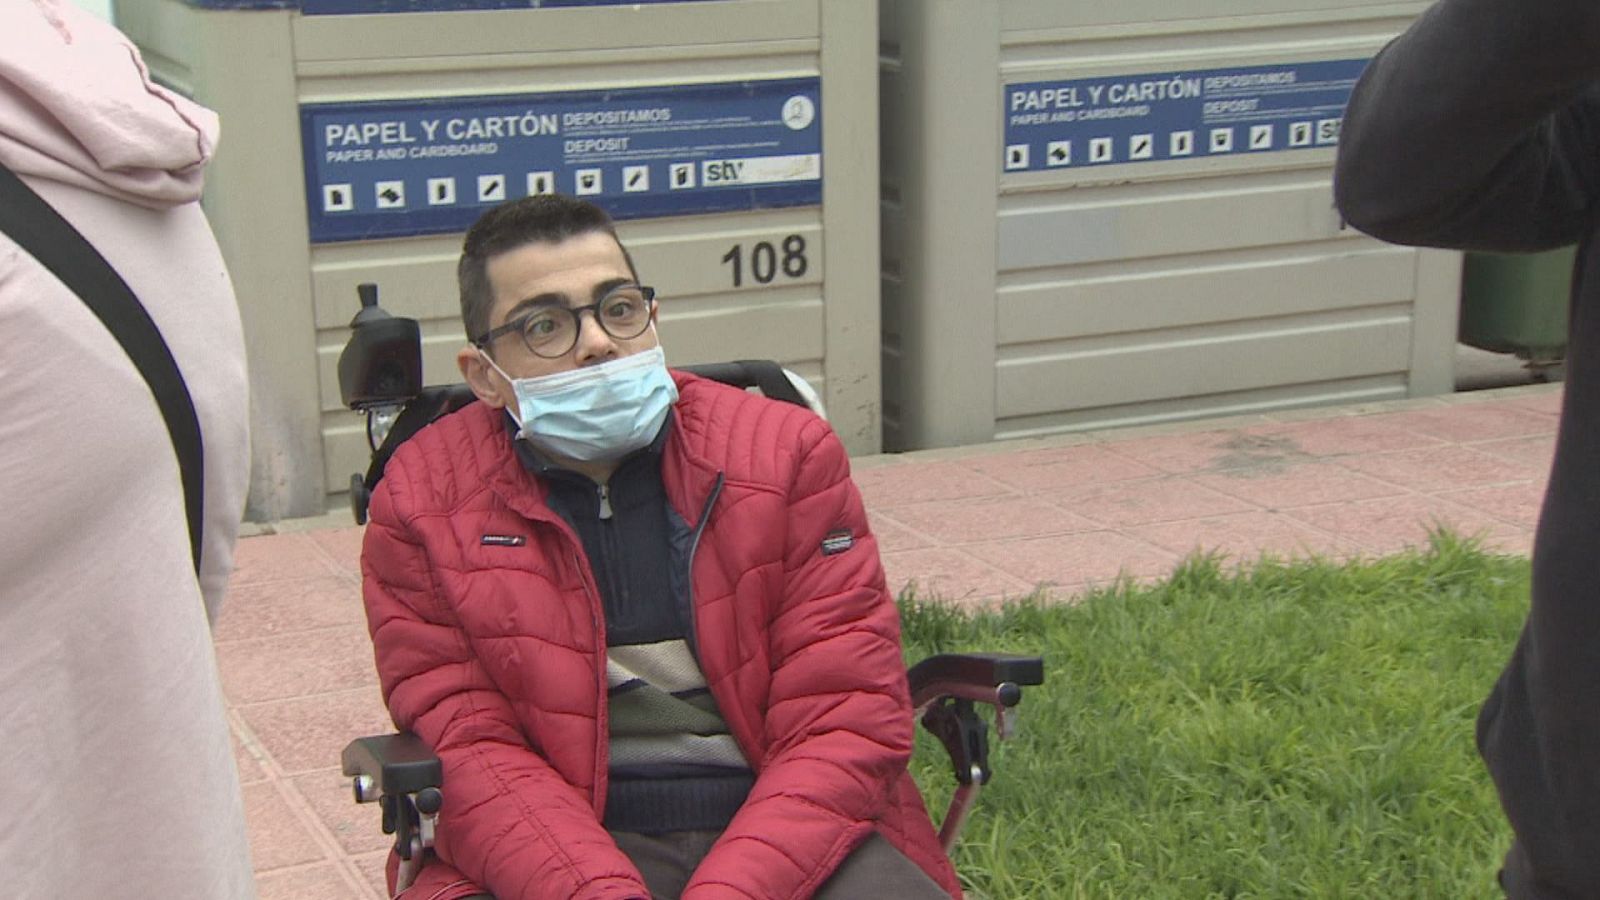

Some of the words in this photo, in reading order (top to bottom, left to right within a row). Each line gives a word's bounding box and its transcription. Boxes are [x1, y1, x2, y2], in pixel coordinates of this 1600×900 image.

[1010, 87, 1084, 112] PAPEL
[1088, 84, 1105, 105] Y
[1108, 75, 1201, 104] CARTÓN
[563, 108, 672, 127] DEPOSITAMOS
[1010, 113, 1049, 126] PAPER
[325, 121, 416, 147] PAPEL
[421, 119, 440, 141] Y
[446, 110, 559, 141] CARTÓN
[326, 150, 374, 163] PAPER
[375, 147, 405, 161] AND
[409, 142, 499, 159] CARDBOARD
[564, 137, 631, 153] DEPOSIT
[721, 234, 808, 288] 108
